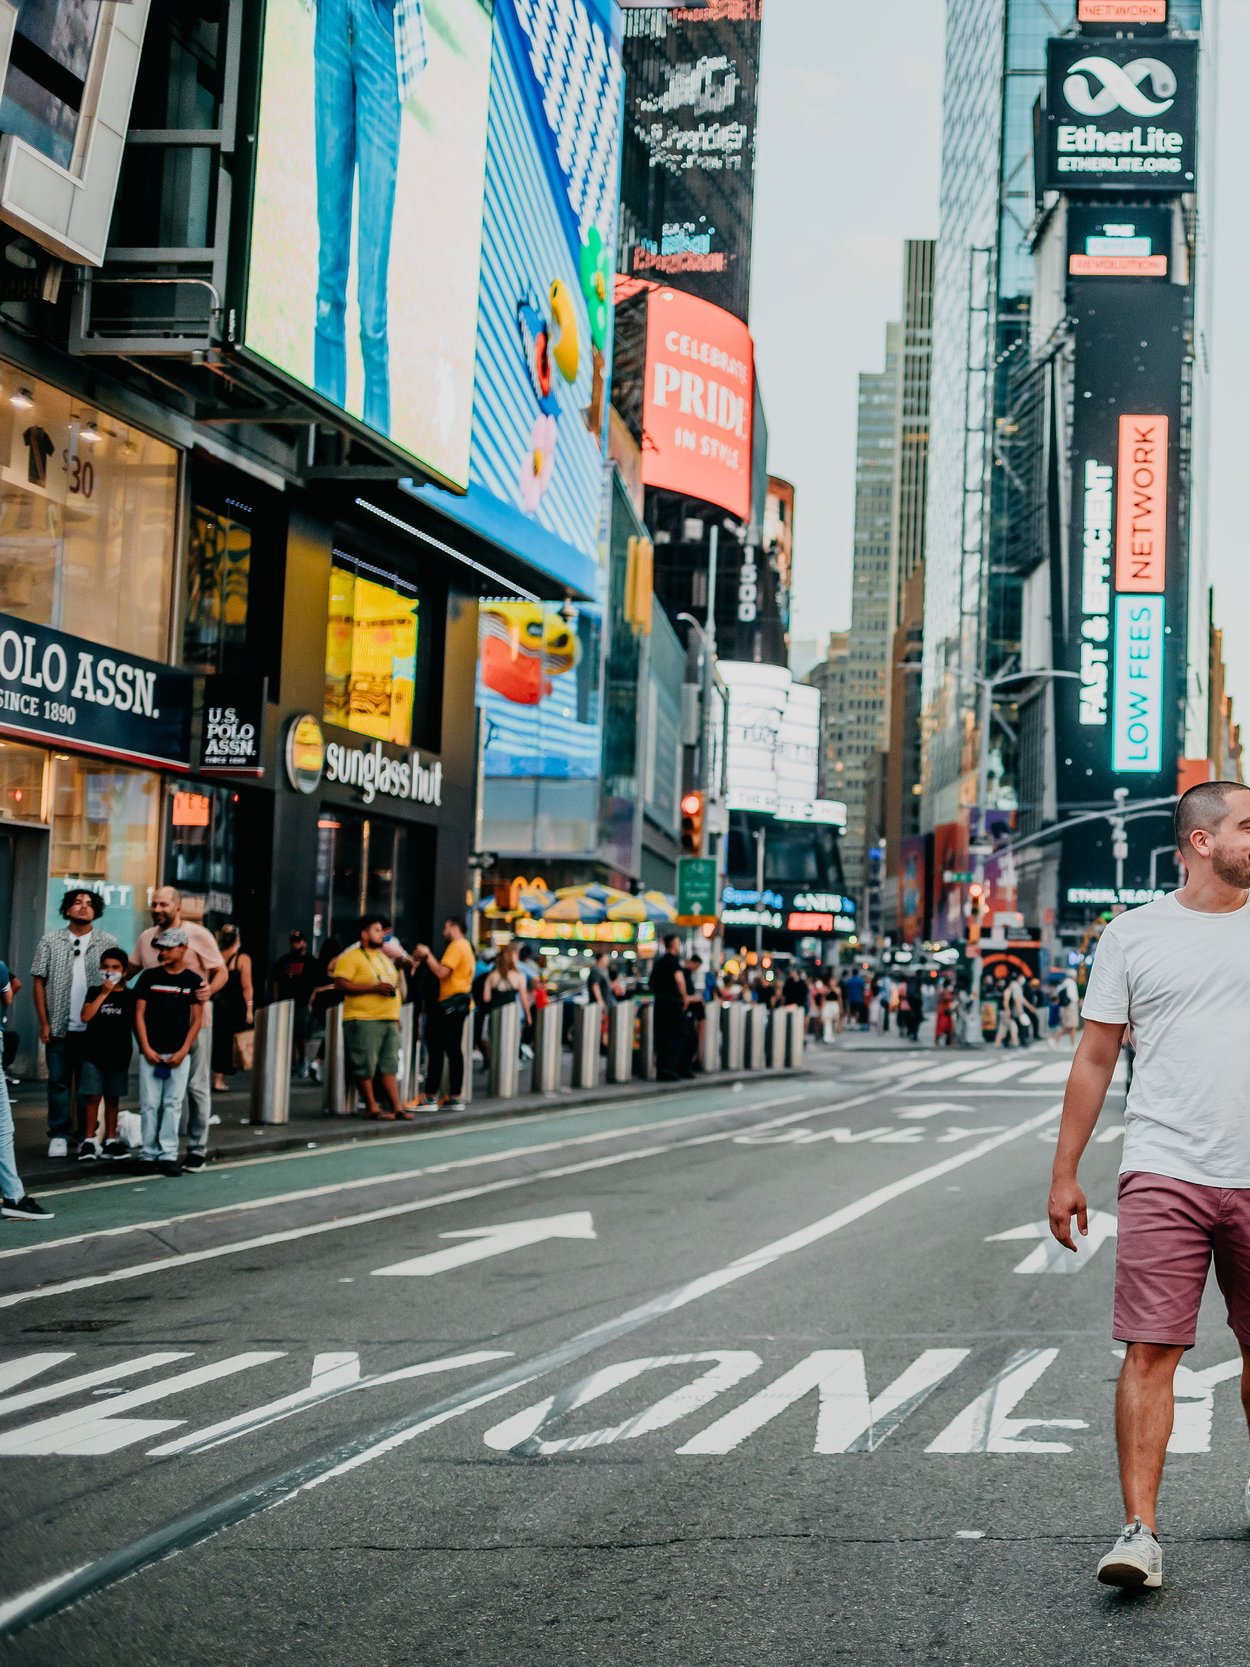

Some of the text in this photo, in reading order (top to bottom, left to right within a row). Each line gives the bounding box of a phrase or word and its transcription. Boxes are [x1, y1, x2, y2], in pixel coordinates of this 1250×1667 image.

[1057, 125, 1183, 153] EtherLite
[1058, 157, 1182, 172] ETHERLITE.ORG
[665, 330, 748, 385] CELEBRATE
[653, 362, 748, 441] PRIDE
[674, 426, 697, 450] IN
[1132, 426, 1155, 579] NETWORK
[1079, 459, 1113, 725] FAST & EFFICIENT
[71, 652, 160, 719] ASSN.
[1127, 607, 1151, 760] LOW FEES
[0, 689, 76, 725] SINCE 1890
[209, 707, 240, 724] U.S.
[205, 739, 257, 756] ASSN.
[207, 723, 255, 740] POLO
[326, 740, 442, 807] sunglass hut
